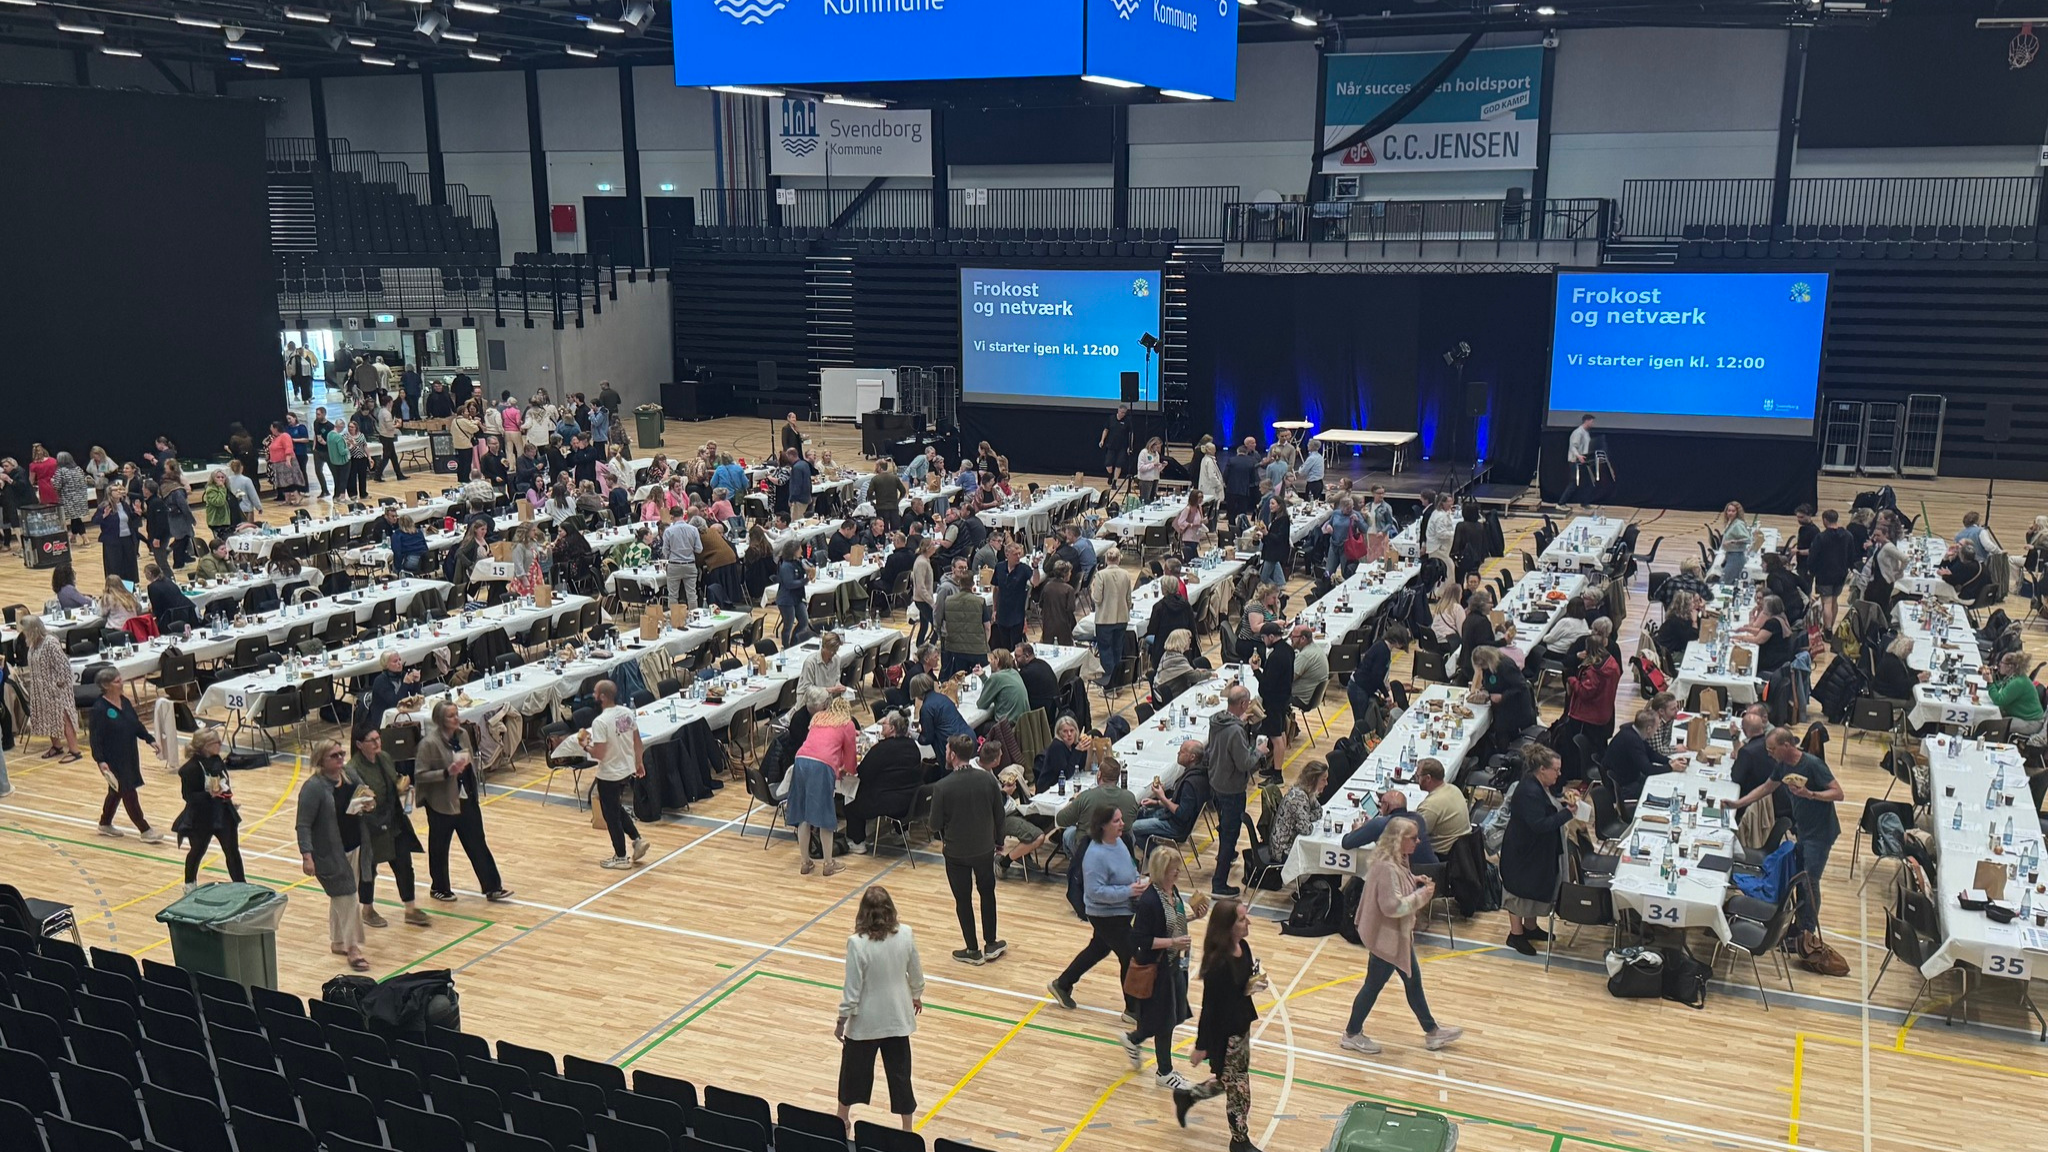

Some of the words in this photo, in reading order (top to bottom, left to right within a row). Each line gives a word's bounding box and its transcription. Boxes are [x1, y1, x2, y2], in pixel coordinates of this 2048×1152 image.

[1153, 0, 1198, 32] Kommune
[1336, 81, 1361, 95] Når
[1364, 83, 1411, 95] succes
[1456, 76, 1531, 94] holdsport
[1483, 103, 1501, 115] GOD
[1501, 94, 1528, 109] KAMP!
[830, 118, 922, 143] Svendborg
[830, 142, 882, 155] Kommune
[973, 281, 1039, 297] Frokost
[1572, 287, 1662, 304] Frokost
[973, 301, 994, 317] og
[1000, 300, 1073, 316] netværk
[1570, 310, 1599, 328] og
[1606, 307, 1707, 324] netværk
[973, 340, 986, 351] Vi
[989, 341, 1030, 353] starter
[1033, 342, 1060, 356] igen
[1063, 343, 1079, 355] kl.
[1082, 344, 1119, 356] 12:00
[1567, 354, 1583, 366] Vi
[1587, 355, 1644, 367] starter
[1648, 354, 1684, 370] igen
[1689, 356, 1710, 368] kl.
[1715, 356, 1765, 369] 12:00
[991, 518, 997, 526] 5
[1122, 527, 1129, 536] 6
[239, 542, 250, 551] 13
[1407, 547, 1415, 556] 8
[362, 554, 373, 563] 14
[1564, 558, 1572, 567] 9
[492, 566, 505, 576] 15
[1915, 583, 1931, 593] 11
[228, 694, 243, 708] 28
[1945, 709, 1969, 723] 23
[1324, 850, 1351, 868] 33
[1648, 904, 1680, 923] 34
[1989, 955, 2025, 975] 35
